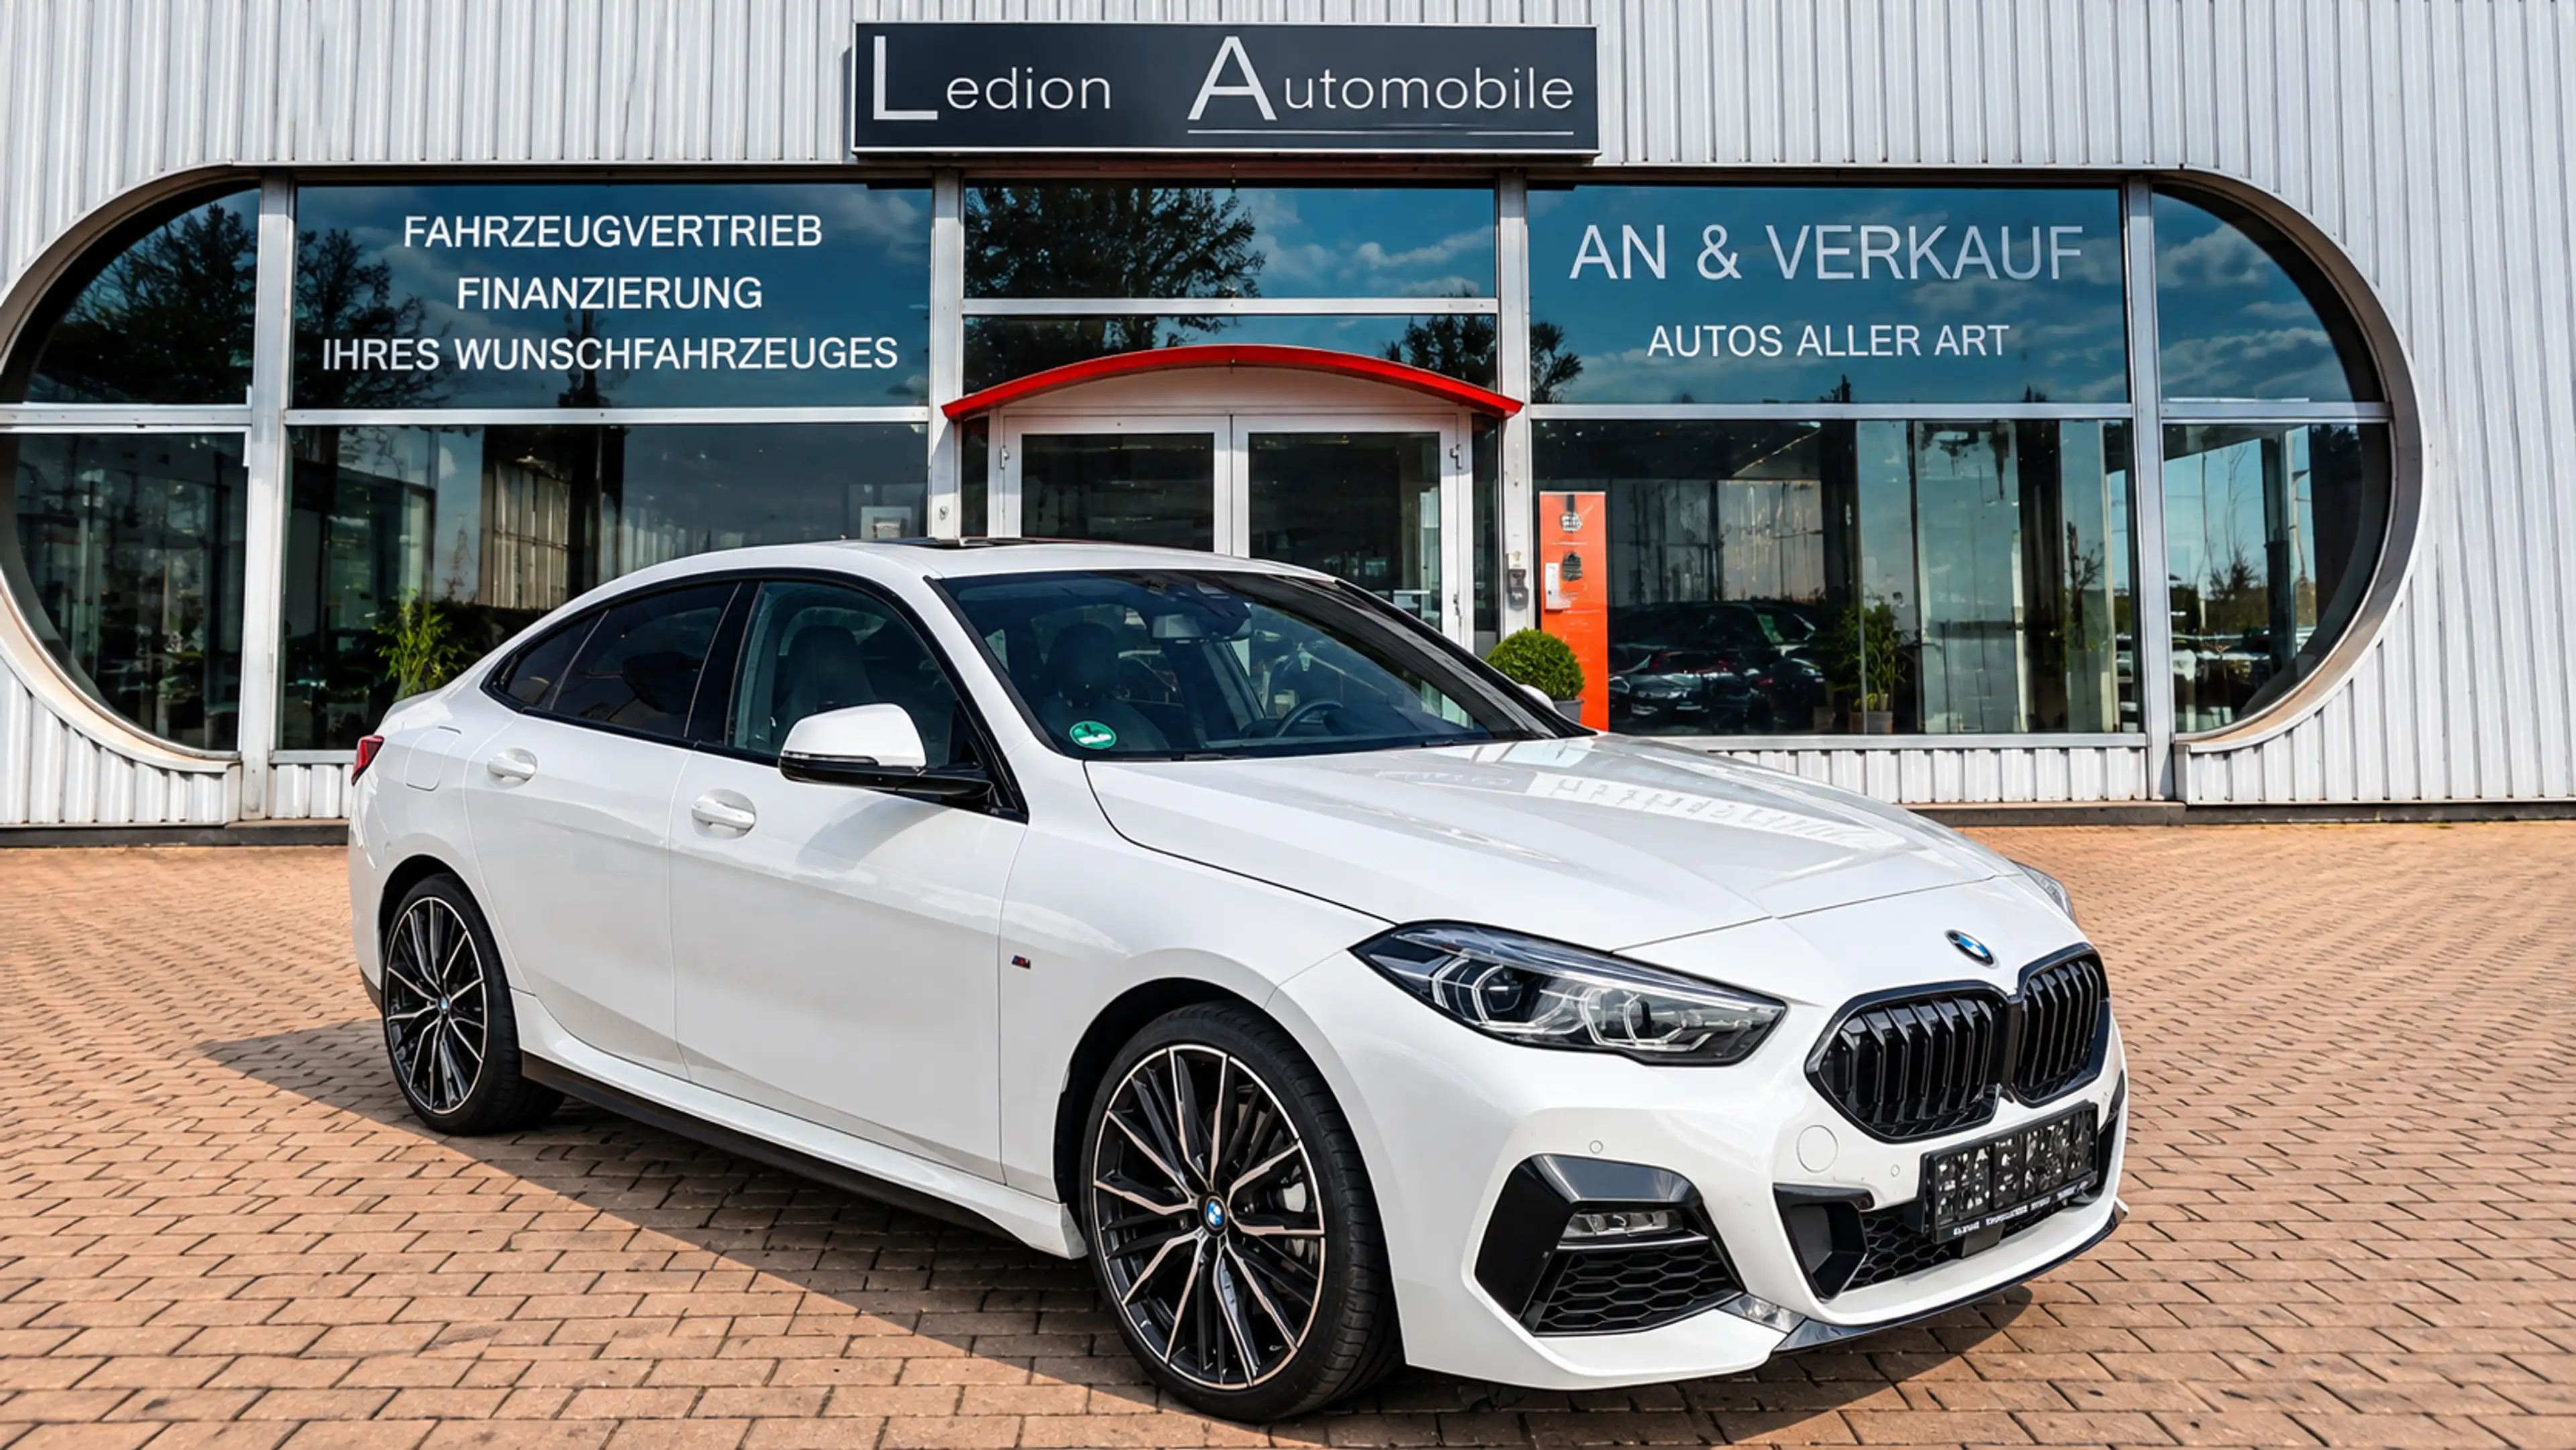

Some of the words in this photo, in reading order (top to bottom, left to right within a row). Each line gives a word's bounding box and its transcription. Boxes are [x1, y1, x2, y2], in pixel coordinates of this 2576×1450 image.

[873, 35, 1112, 121] Ledion
[1187, 35, 1574, 121] Automobile
[404, 215, 823, 248] FAHRZEUGVERTRIEB
[1569, 224, 1666, 280] AN
[1697, 224, 1742, 280] &
[1765, 225, 2083, 280] VERKAUF
[458, 276, 763, 310] FINANZIERUNG
[323, 338, 440, 371] IHRES
[454, 337, 898, 370] WUNSCHFAHRZEUGES
[1647, 325, 1783, 357] AUTOS
[1796, 325, 1921, 356] ALLER
[1934, 325, 2010, 356] ART
